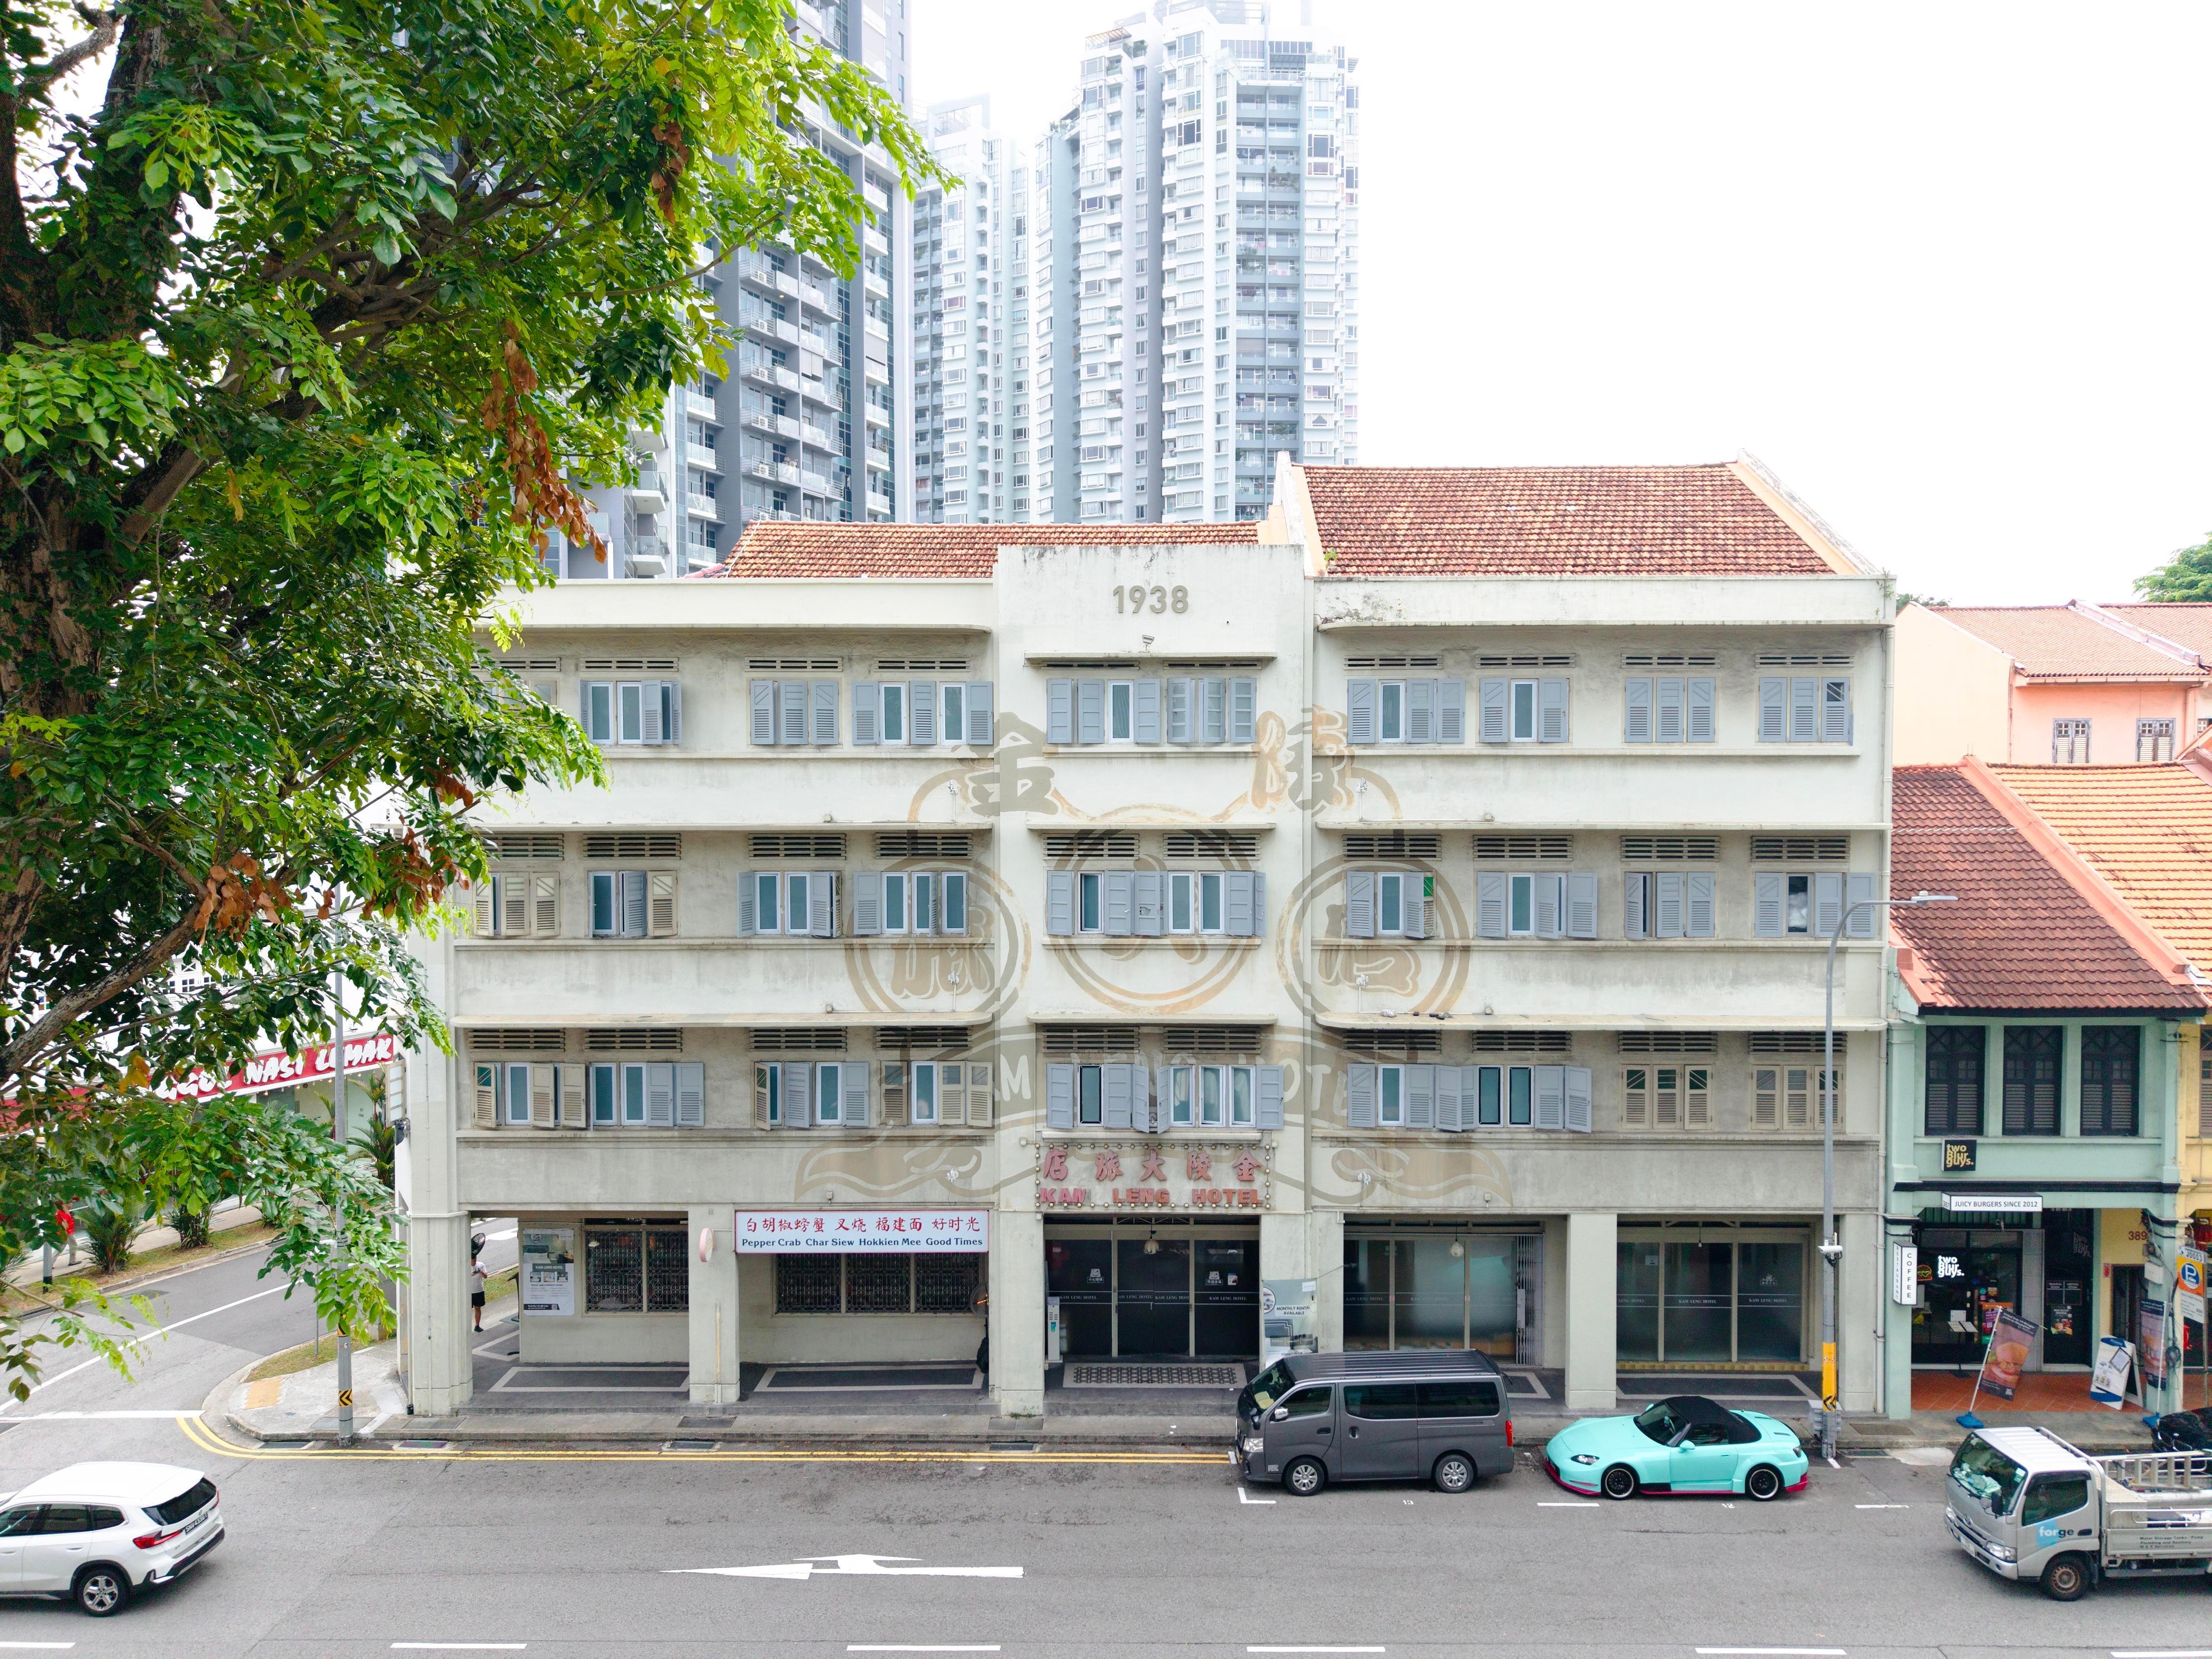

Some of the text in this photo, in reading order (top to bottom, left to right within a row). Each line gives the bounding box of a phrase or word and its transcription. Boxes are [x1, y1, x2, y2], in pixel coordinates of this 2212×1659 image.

[1113, 585, 1189, 613] 1938
[244, 1052, 304, 1084] NASI
[1947, 1151, 1968, 1160] Blur
[1946, 1158, 1974, 1167] guys.
[1041, 1188, 1264, 1204] KAM LENG HOTEL
[746, 1216, 981, 1232] 白胡椒螃蟹 叉烧 福建面 好时光
[2128, 1231, 2147, 1240] 389
[742, 1238, 775, 1248] Pepper
[778, 1238, 801, 1246] Crab
[806, 1238, 829, 1246] Char
[831, 1238, 854, 1246] Siew
[859, 1238, 899, 1246] Hokkien
[1938, 1255, 1958, 1264] two
[1938, 1268, 1965, 1278] guys.
[2040, 1527, 2074, 1539] forge
